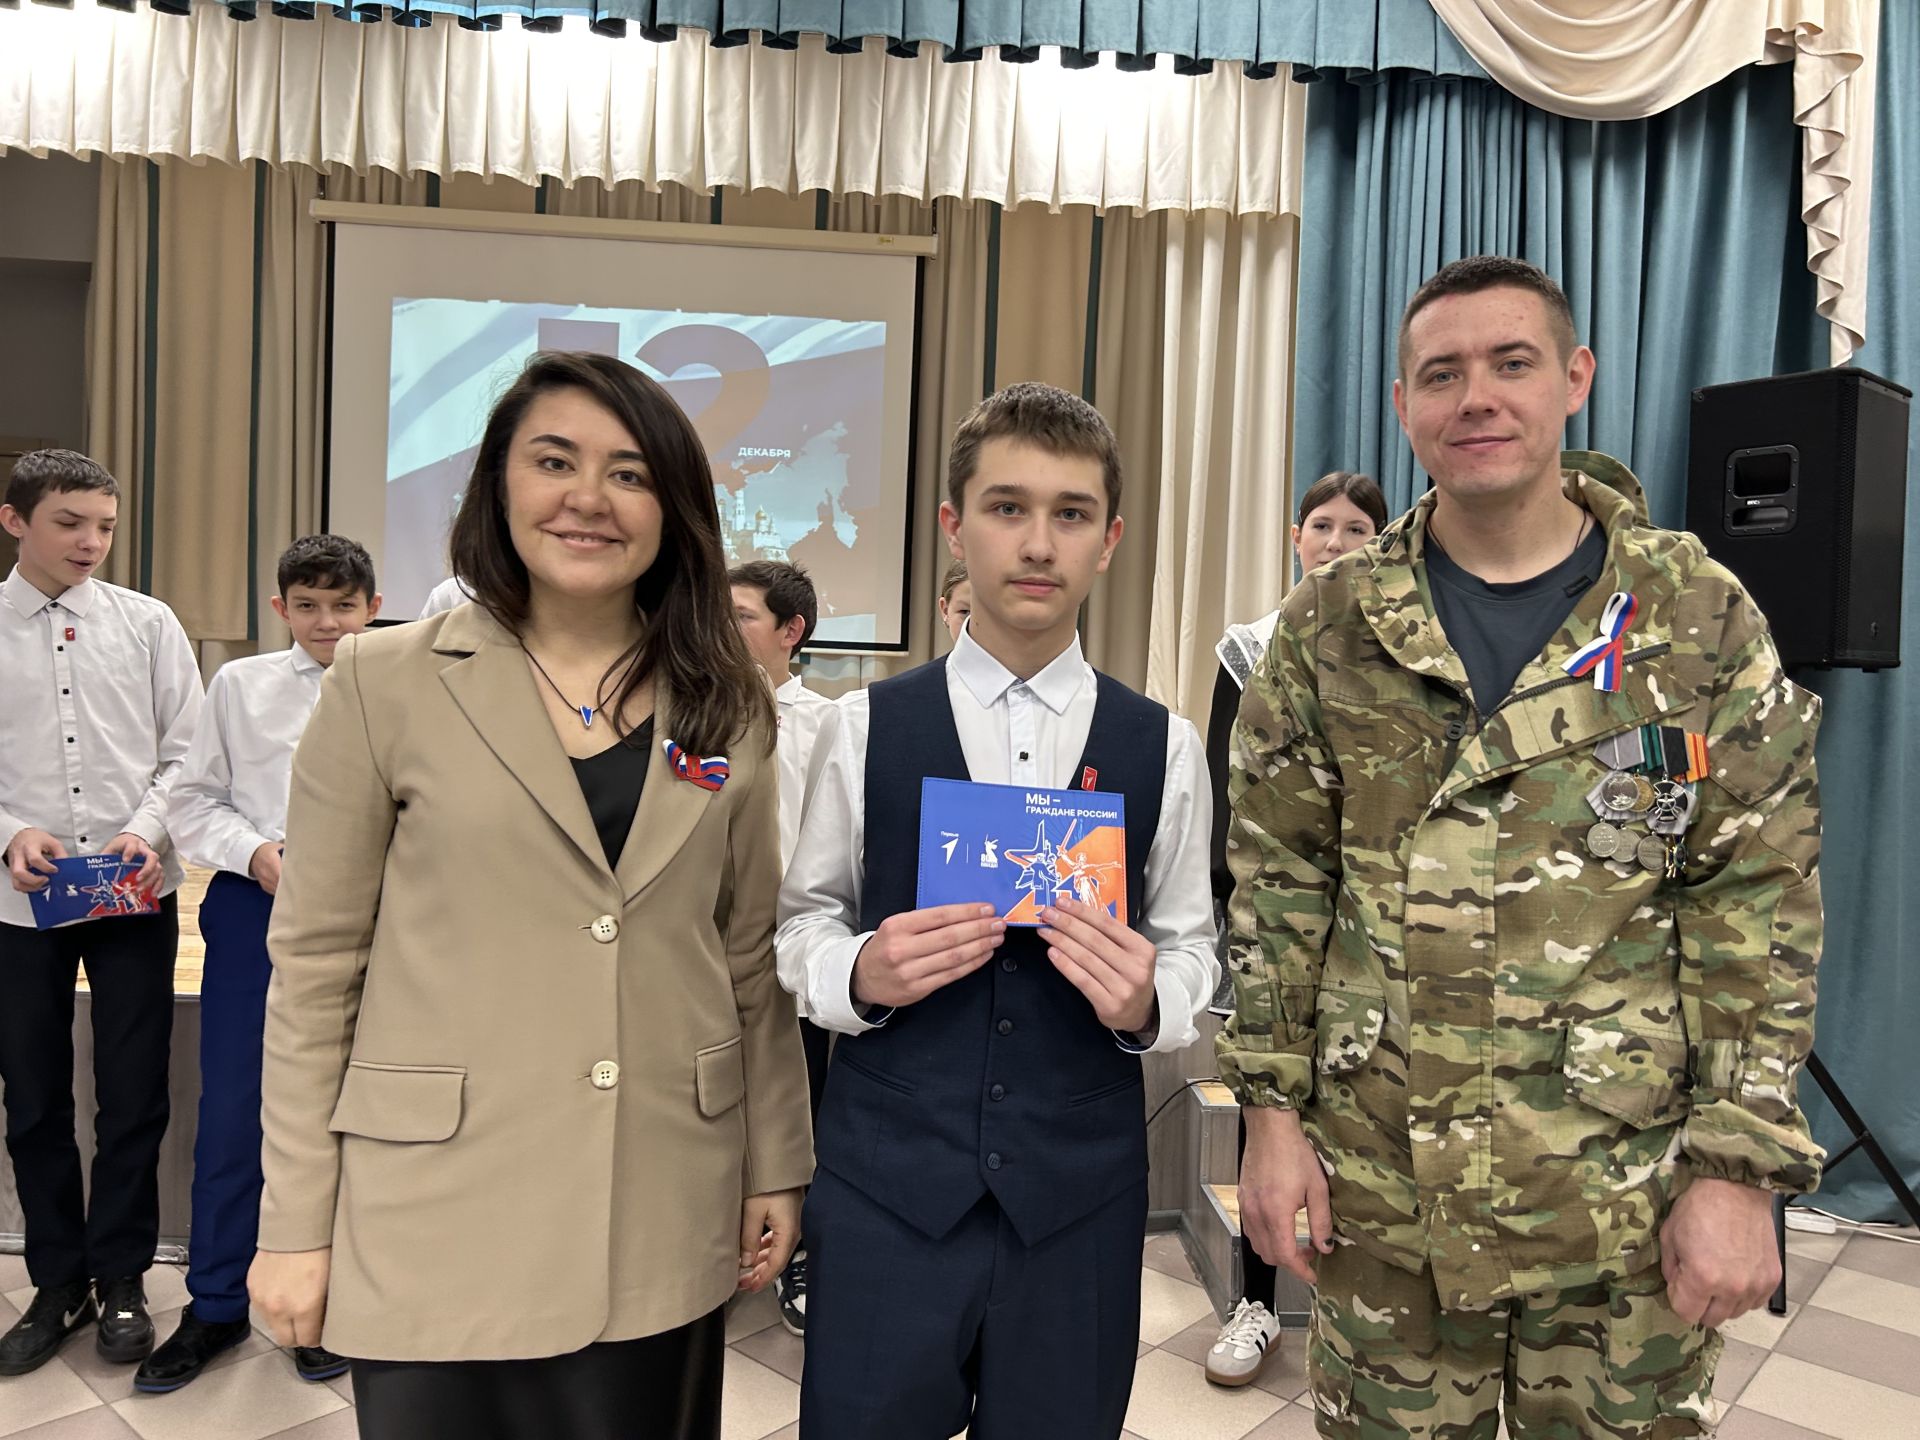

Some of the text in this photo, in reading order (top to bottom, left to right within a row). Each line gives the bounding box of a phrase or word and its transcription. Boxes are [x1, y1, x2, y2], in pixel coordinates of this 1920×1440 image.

[738, 447, 791, 458] ДЕКАБРЯ
[1025, 792, 1050, 806] МЫ
[1025, 806, 1117, 819] ГРАЖДАНЕ РОССИИ!
